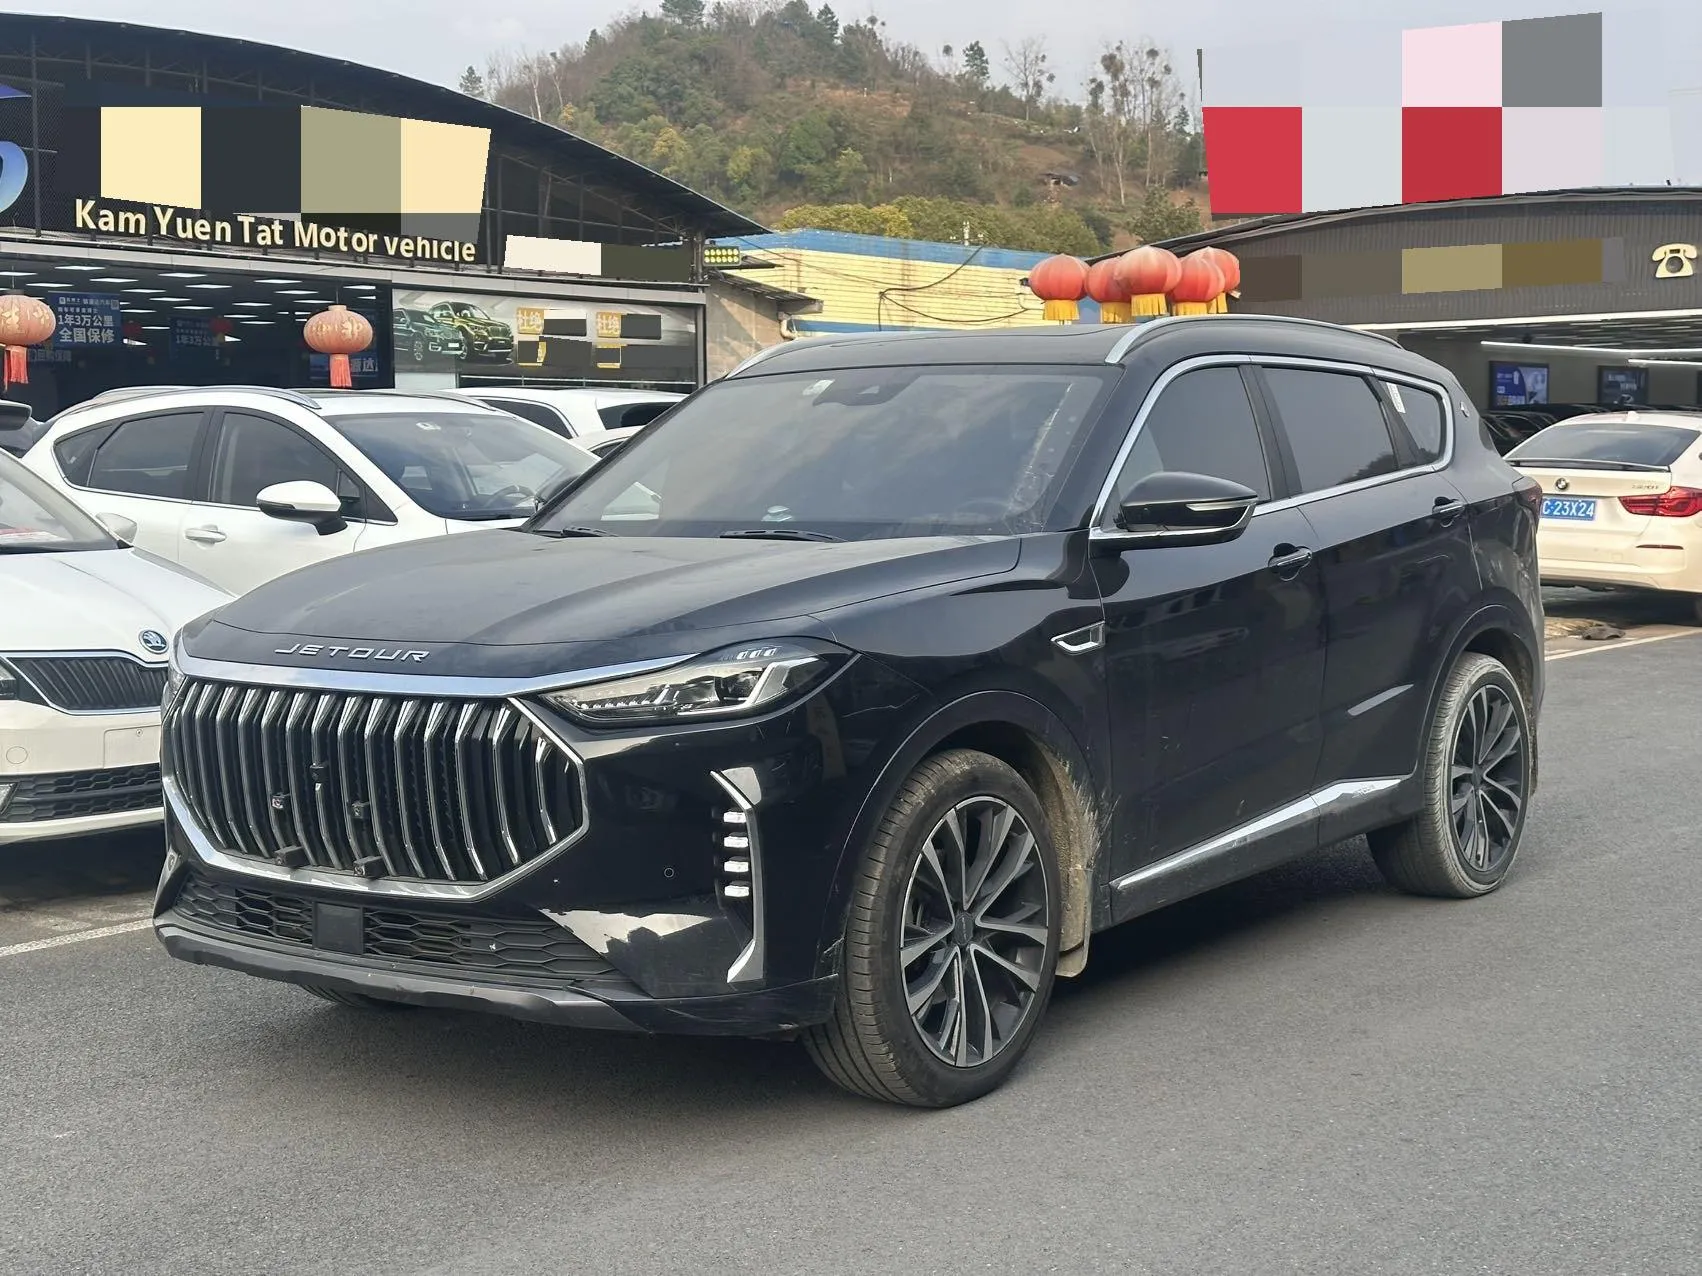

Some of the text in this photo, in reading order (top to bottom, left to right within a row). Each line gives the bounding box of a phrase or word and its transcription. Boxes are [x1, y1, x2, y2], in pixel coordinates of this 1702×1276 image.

[75, 198, 147, 236] Kam
[153, 206, 232, 244] Yuen
[237, 213, 284, 247] Tat
[293, 220, 379, 254] Motor
[57, 314, 114, 327] 1年3万公里
[58, 327, 115, 344] 全国保修
[274, 643, 429, 661] JETOUR
